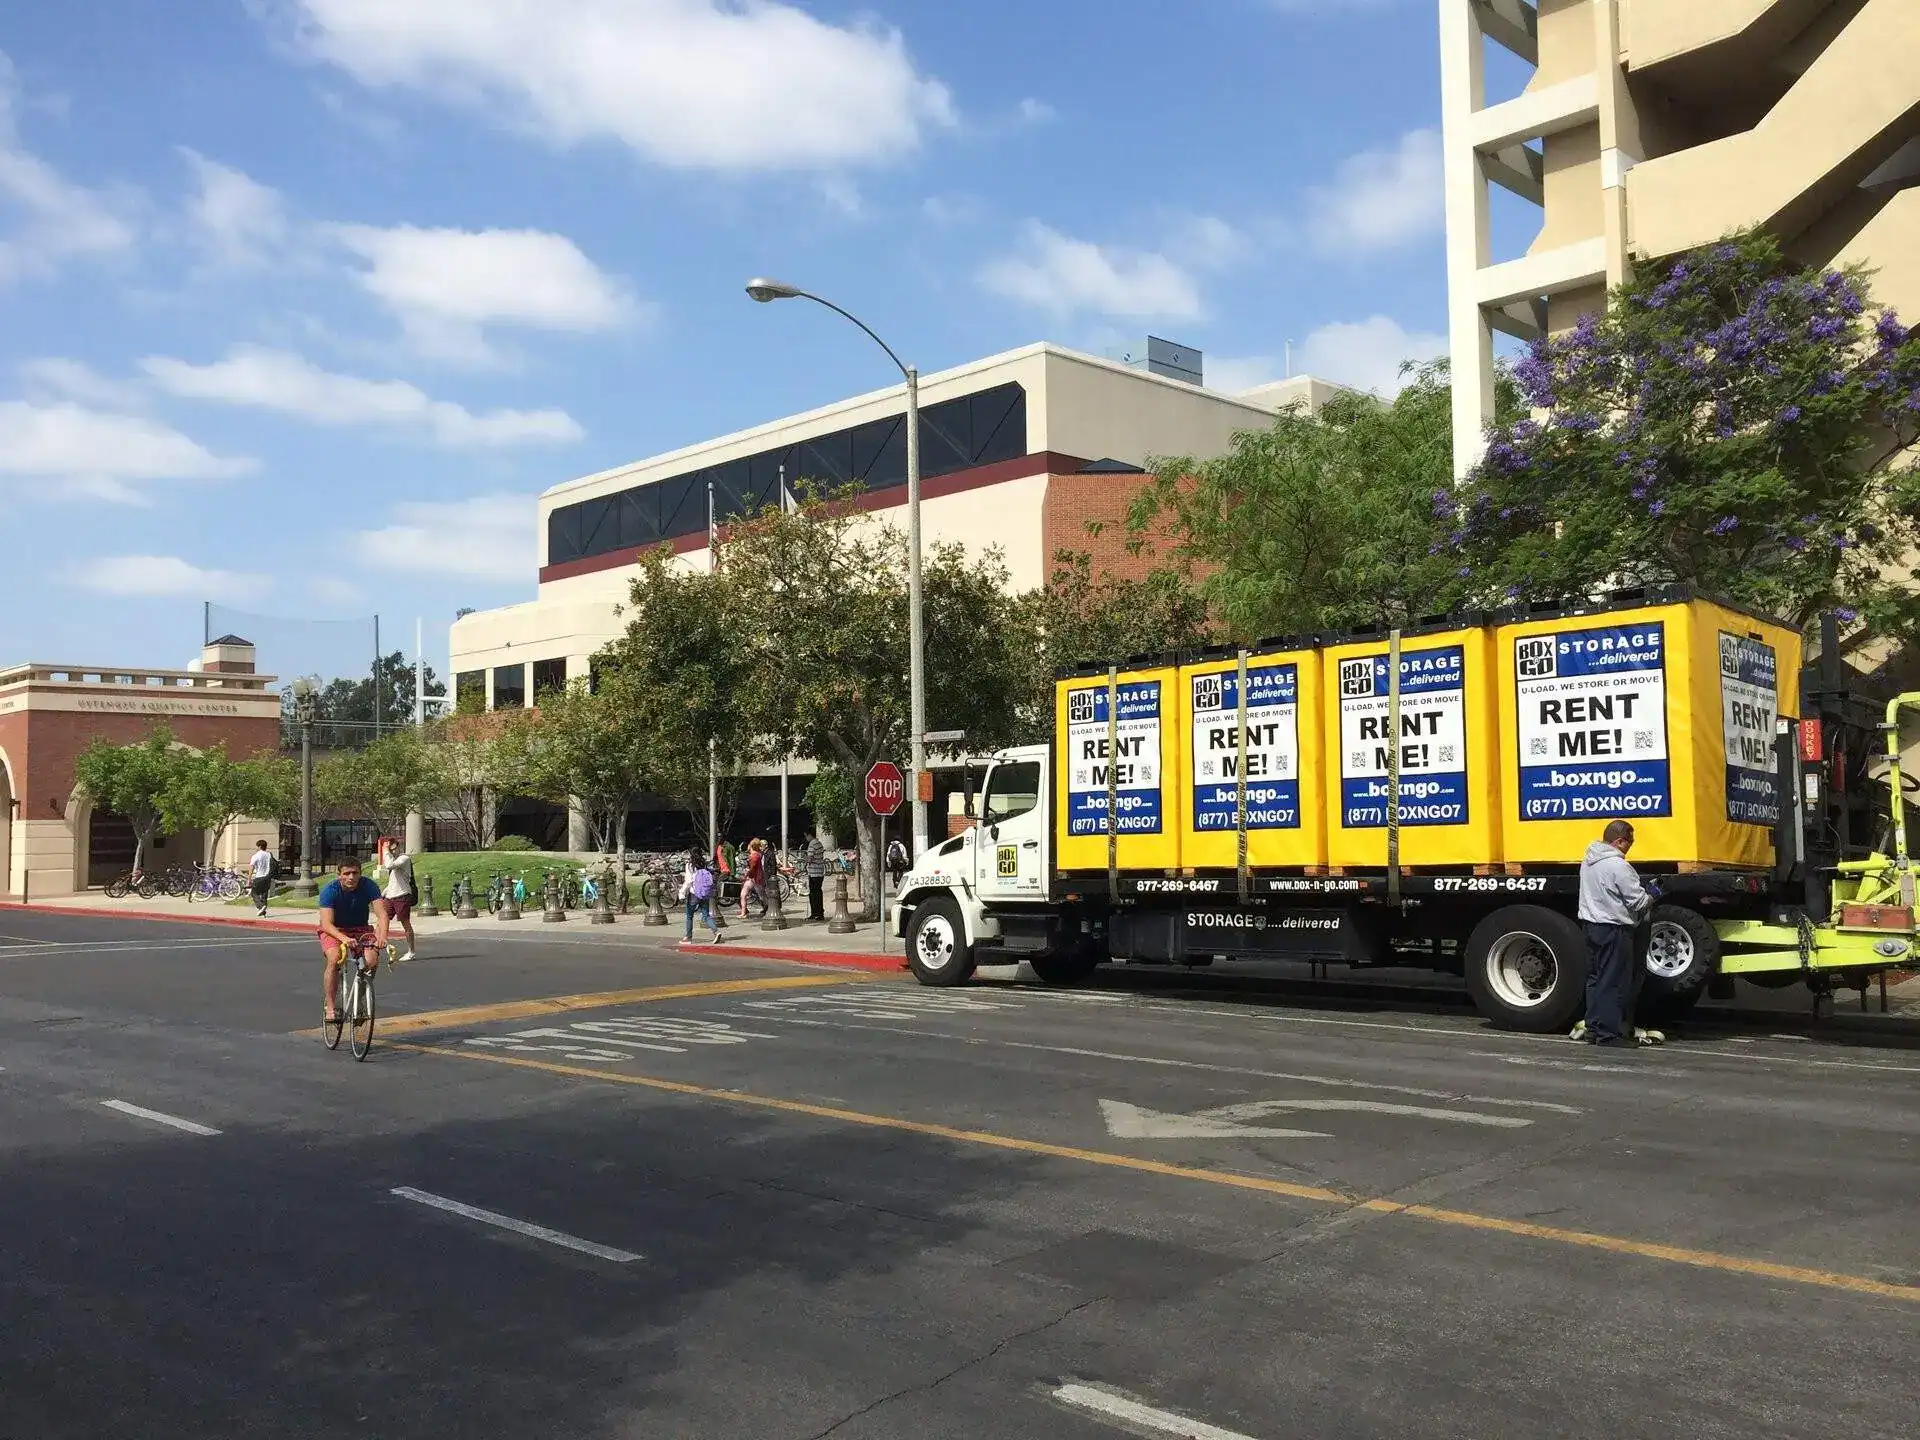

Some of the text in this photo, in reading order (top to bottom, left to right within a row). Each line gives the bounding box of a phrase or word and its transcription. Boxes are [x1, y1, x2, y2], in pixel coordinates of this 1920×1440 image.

[1519, 641, 1553, 660] BOX
[1559, 633, 1660, 654] STORAGE
[1376, 656, 1461, 676] SORAGE
[1519, 657, 1554, 676] GO
[1588, 650, 1659, 666] ...delivered
[1738, 647, 1775, 669] STORAGE
[1342, 662, 1371, 680] BOX
[1195, 678, 1219, 694] BOX
[1343, 677, 1372, 695] GO
[1560, 683, 1575, 691] WE
[1577, 680, 1610, 689] STORE
[1612, 678, 1628, 686] OR
[1629, 675, 1660, 685] MOVE
[198, 703, 238, 713] CENTER
[1070, 692, 1093, 707] BOX
[1195, 692, 1220, 708] GO
[1377, 701, 1389, 709] WE
[1398, 699, 1418, 707] TORE
[1434, 695, 1460, 703] MOVE
[1539, 693, 1640, 725] RENT
[1070, 706, 1093, 720] GO
[1261, 710, 1271, 718] OR
[1731, 700, 1770, 732] RENT
[1359, 711, 1444, 740] RENT
[1209, 723, 1279, 750] RENT
[1558, 729, 1623, 758] ME!
[1083, 736, 1145, 759] RENT
[1375, 744, 1429, 770] ME!
[1740, 736, 1767, 765] ME!
[1222, 753, 1267, 777] ME!
[1388, 749, 1396, 777] PACIFIC
[1092, 764, 1134, 785] ME!
[1532, 769, 1655, 789] www.boxngo.com
[868, 778, 901, 798] STOP
[1387, 779, 1396, 805] CARGO
[1347, 804, 1461, 824] (877) OXNGO7
[1526, 795, 1663, 817] (877) BOXNGO7
[1072, 816, 1157, 832] (877) BXNGO7
[1198, 809, 1294, 828] (877) BXNGO7
[1387, 805, 1396, 843] CONTROL
[998, 848, 1015, 860] BOX
[998, 860, 1016, 874] GO
[909, 875, 952, 887] CA328830
[1136, 880, 1219, 892] 877-269-6467
[1269, 880, 1359, 893] www.box-n-go.com
[1187, 913, 1340, 930] STORAGE ....delivered
[463, 1015, 778, 1062] STOP
